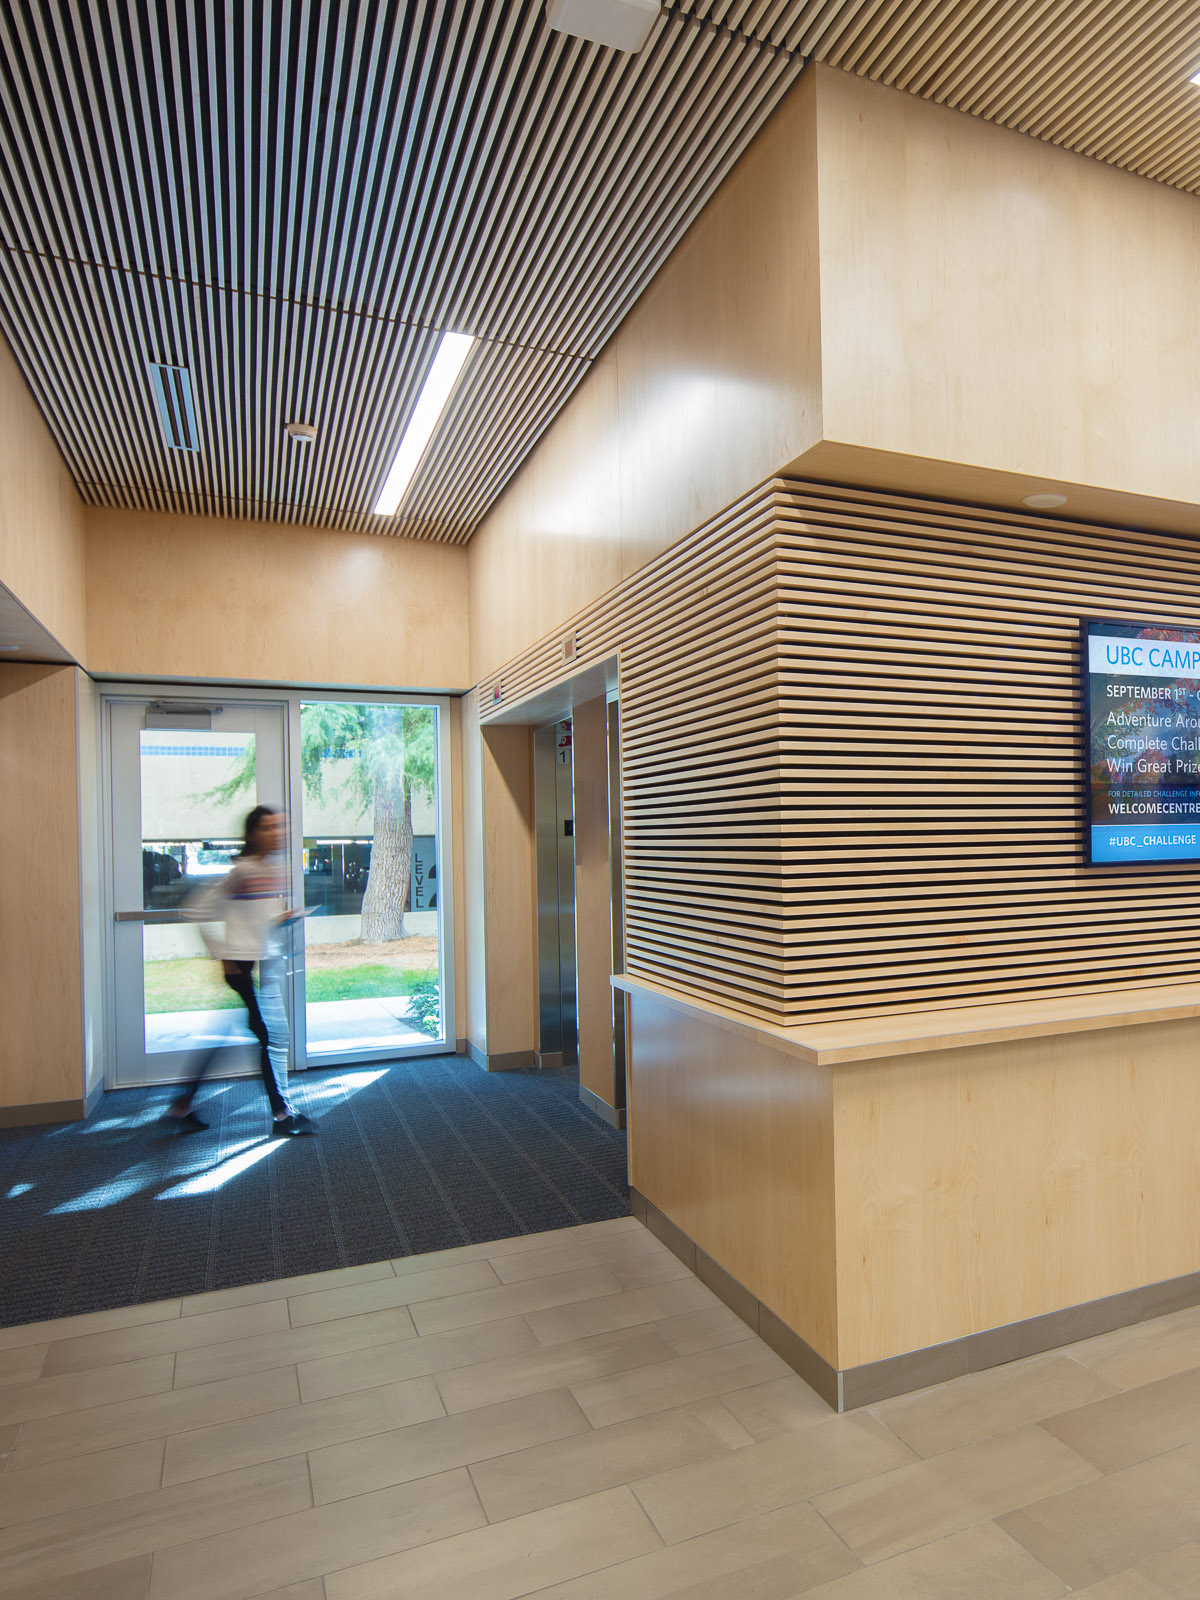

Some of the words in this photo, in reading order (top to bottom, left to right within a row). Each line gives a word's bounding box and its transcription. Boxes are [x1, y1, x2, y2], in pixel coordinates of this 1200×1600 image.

[1106, 644, 1143, 667] UBC
[1106, 684, 1172, 700] SEPTEMBER
[1106, 711, 1172, 728] Adventure
[1107, 734, 1168, 753] Complete
[559, 750, 566, 763] 1
[1106, 758, 1133, 773] Win
[1137, 758, 1172, 774] Great
[1108, 790, 1121, 798] FOR
[1122, 790, 1152, 798] DETAILED
[1153, 790, 1188, 798] CHALLENGE
[1109, 834, 1197, 848] #UBC_CHALLENGE
[414, 852, 425, 909] LEVEL
